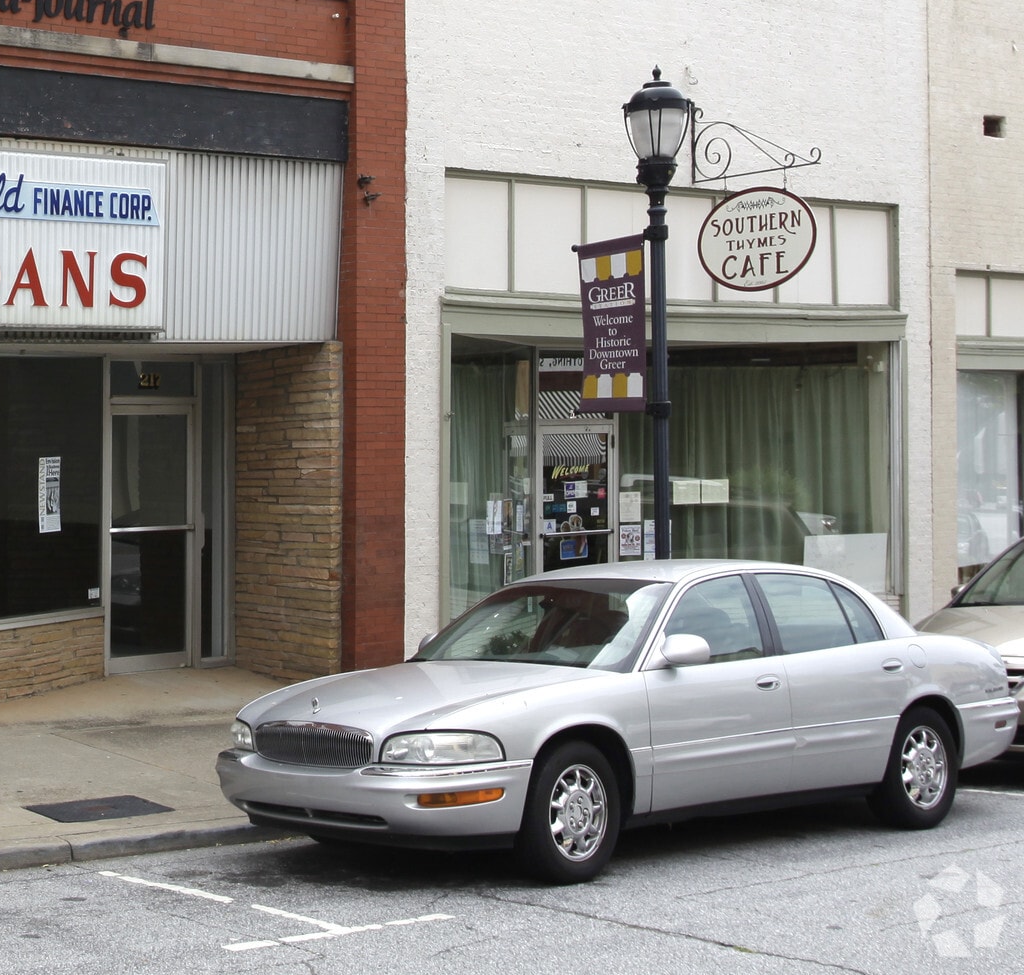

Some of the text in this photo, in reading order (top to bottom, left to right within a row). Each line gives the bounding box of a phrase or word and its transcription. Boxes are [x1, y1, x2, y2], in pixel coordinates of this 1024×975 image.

[33, 187, 104, 218] FINANCE
[109, 192, 152, 221] CORP.
[711, 209, 801, 237] SOUTHERN
[726, 234, 787, 251] THYMES
[722, 250, 789, 280] CAFE
[588, 282, 636, 304] GREER
[593, 314, 634, 327] Welcome
[608, 327, 617, 336] to
[596, 335, 632, 348] Historic
[589, 348, 639, 360] Downtown
[599, 359, 626, 370] Greer
[551, 464, 590, 480] WELCOME
[546, 522, 552, 530] A
